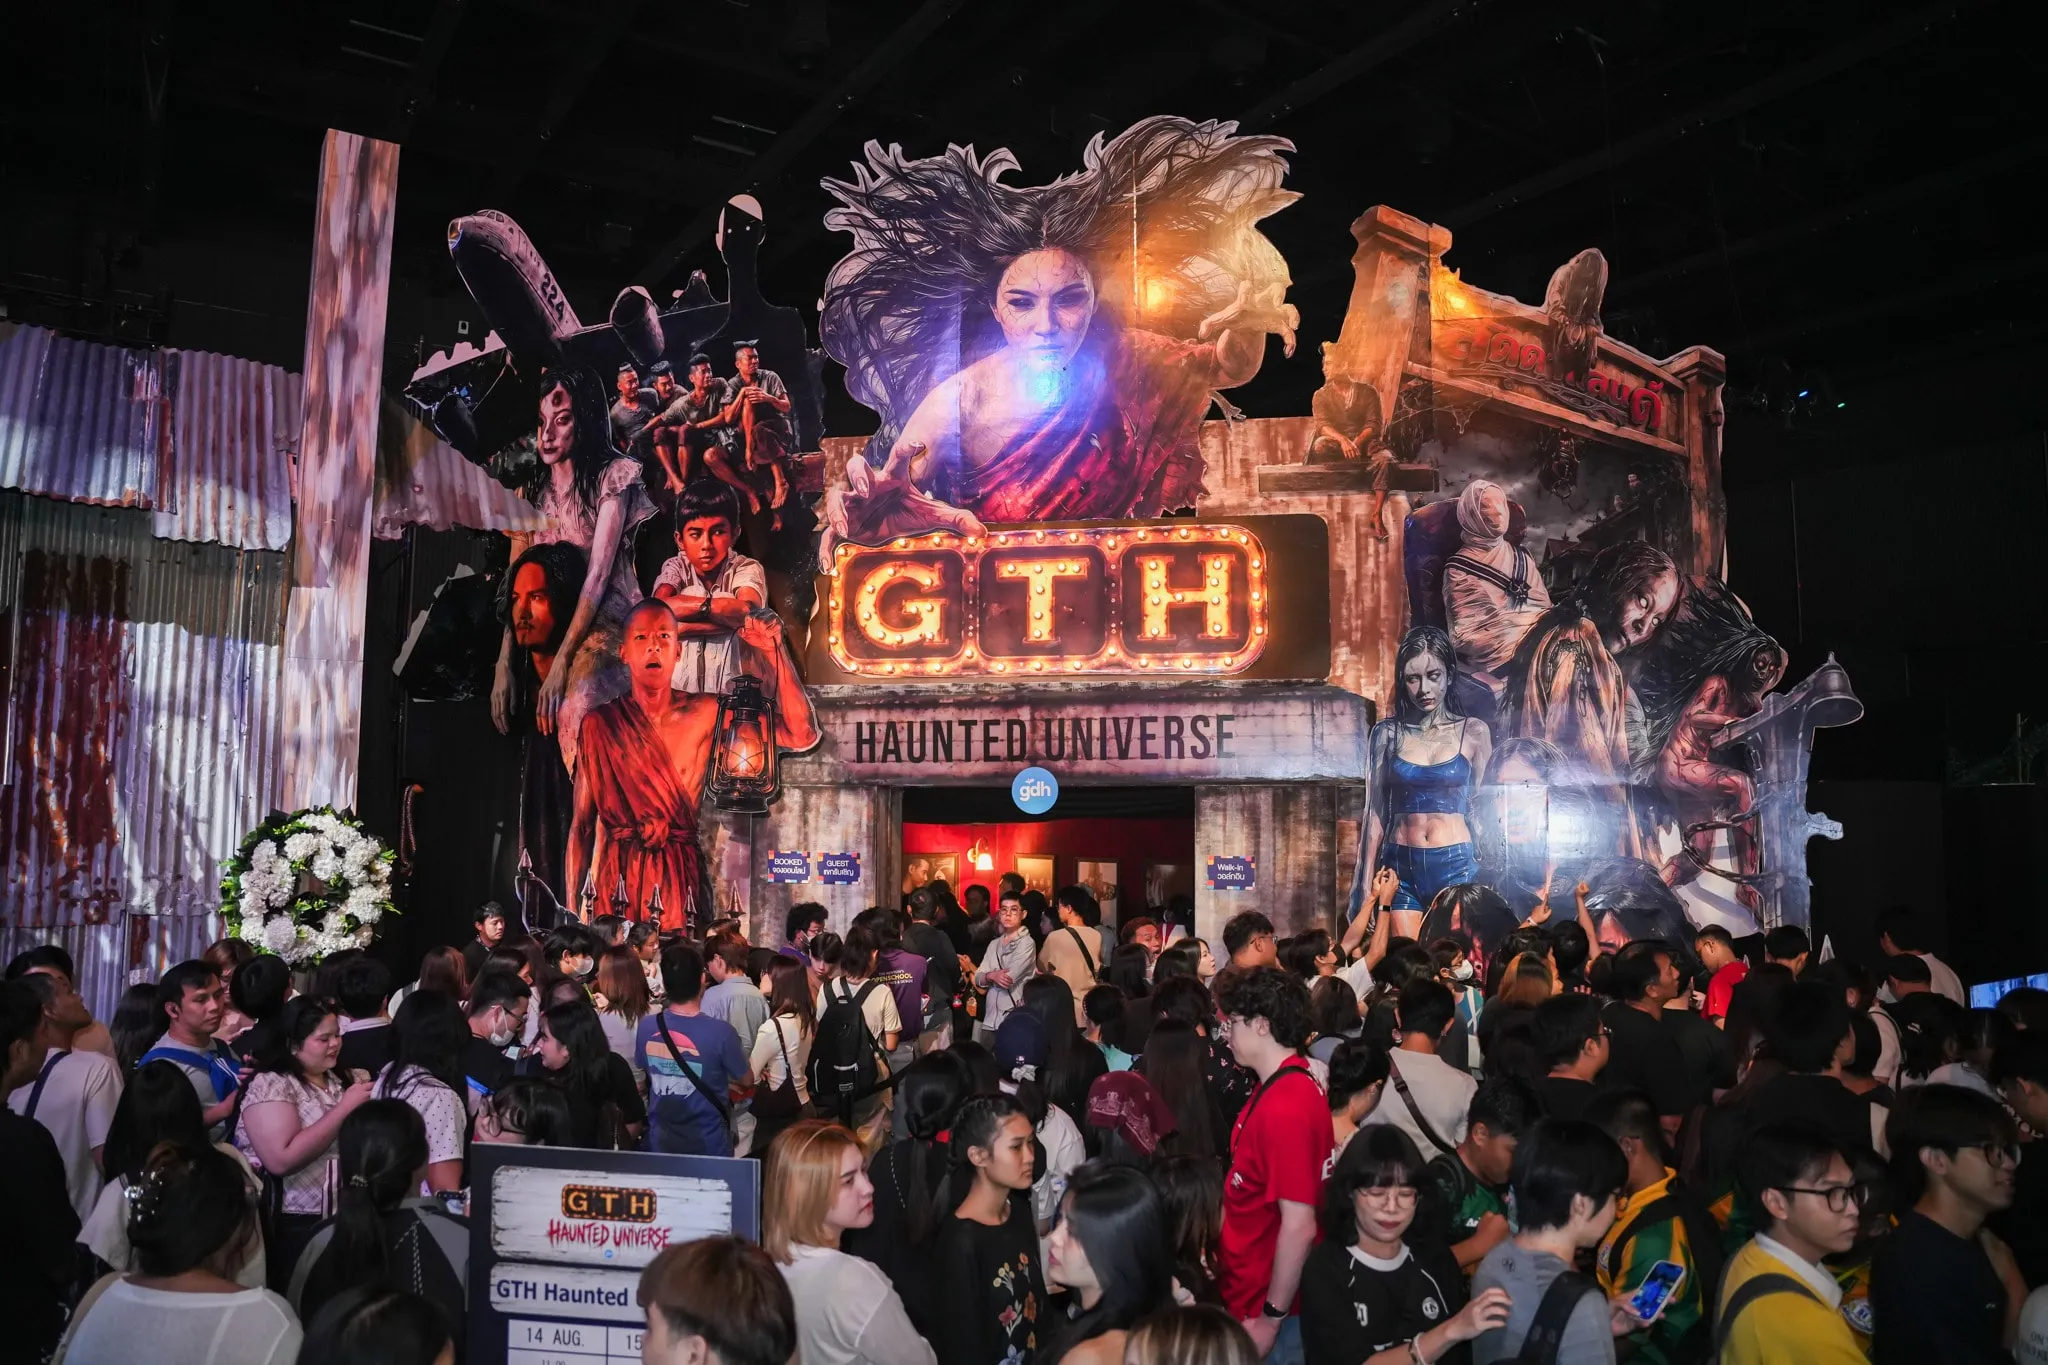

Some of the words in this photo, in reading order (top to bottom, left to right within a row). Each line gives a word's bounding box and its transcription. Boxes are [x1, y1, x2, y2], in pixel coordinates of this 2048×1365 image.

[855, 553, 1237, 651] GTH
[855, 718, 1027, 763] HAUNTED
[1046, 714, 1235, 761] UNIVERSE
[1020, 780, 1051, 801] gdh
[774, 858, 803, 866] BOOKED
[568, 1191, 650, 1215] GTH
[548, 1219, 610, 1248] HAUNTED
[613, 1224, 672, 1250] UNIVERSE
[496, 1279, 537, 1300] GTH
[544, 1283, 629, 1306] Haunted
[526, 1327, 543, 1344] 14
[552, 1329, 585, 1347] AUG.
[626, 1334, 643, 1350] 15
